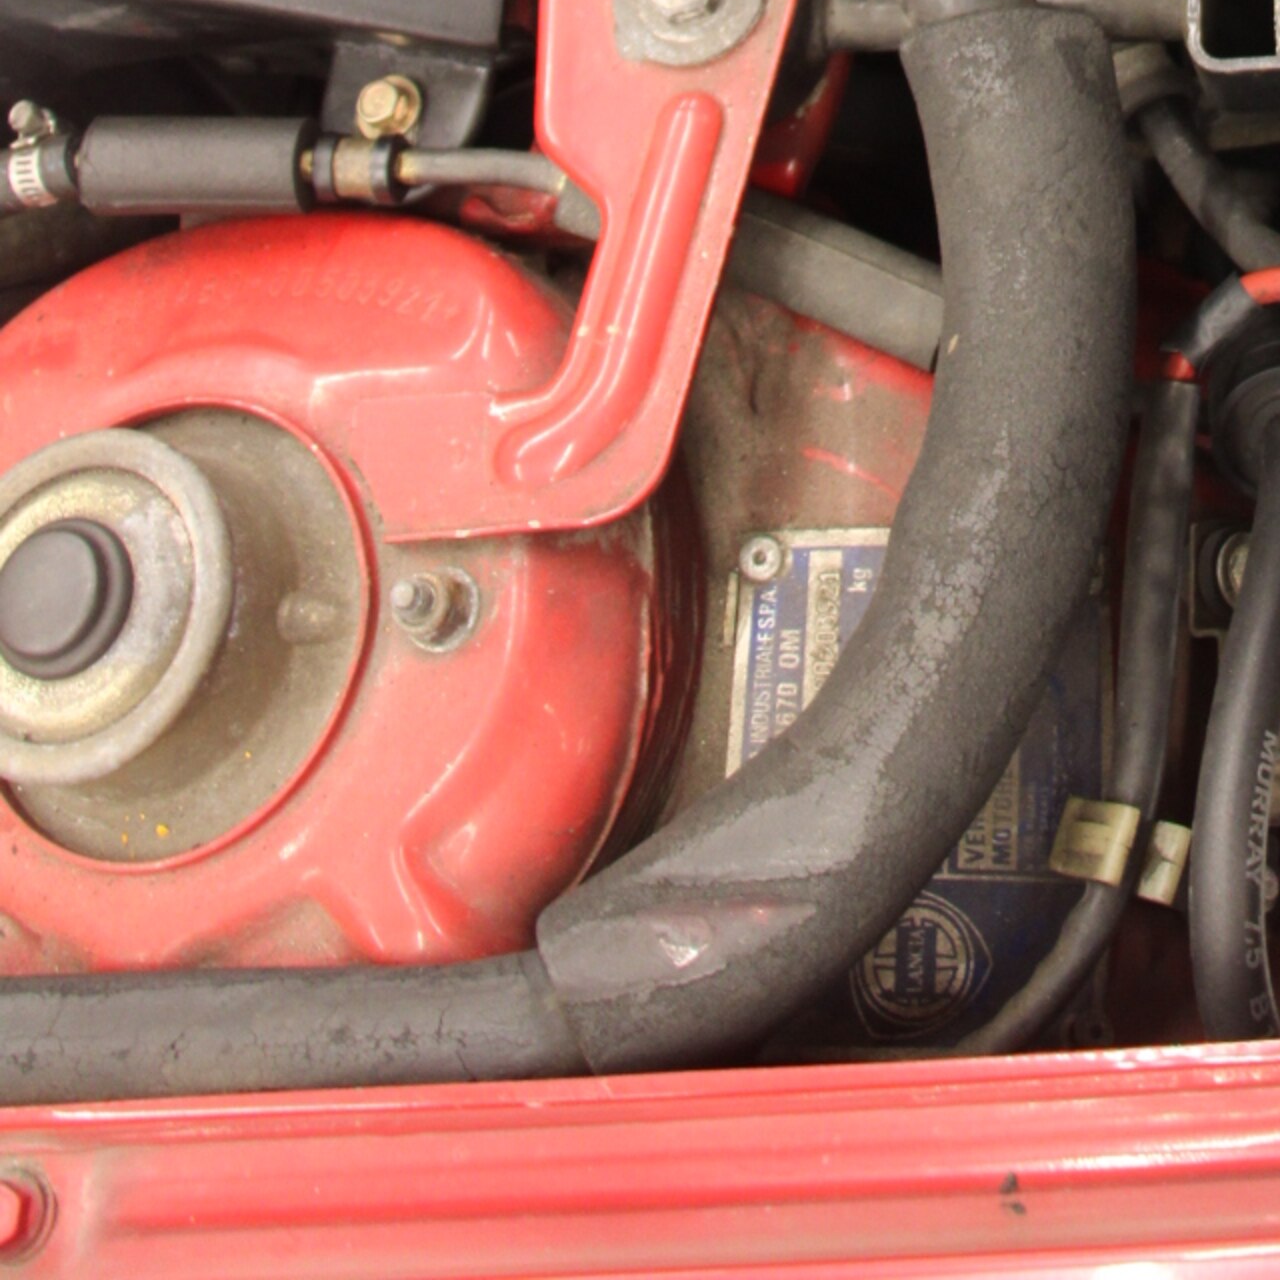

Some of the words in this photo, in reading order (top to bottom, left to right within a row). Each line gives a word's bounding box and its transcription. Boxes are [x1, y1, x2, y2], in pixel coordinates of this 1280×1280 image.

[846, 567, 871, 592] kg
[751, 630, 775, 743] INDUSTRIALE
[1244, 728, 1277, 884] MURRAY
[904, 928, 926, 993] LANCIA
